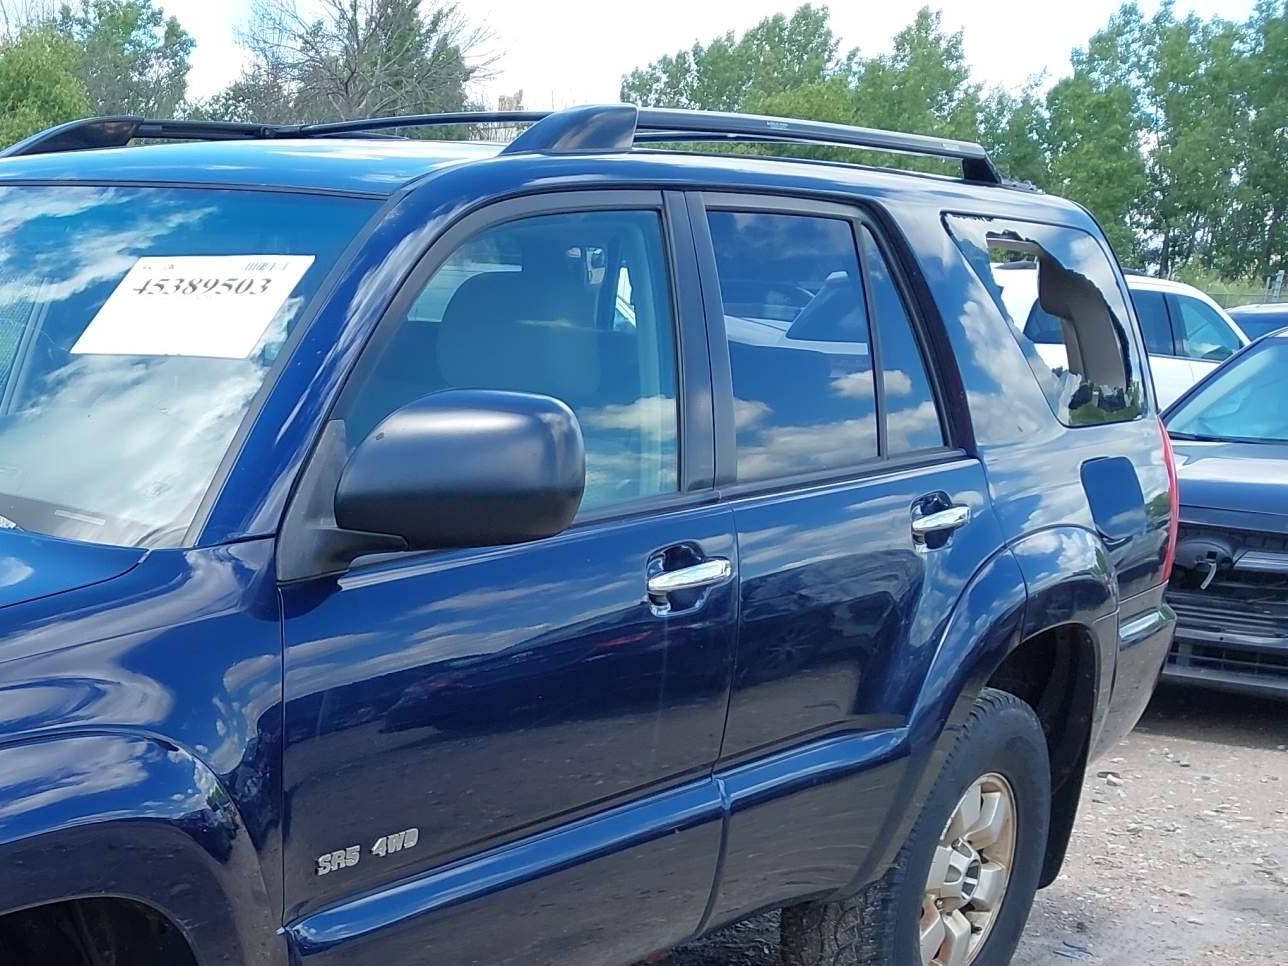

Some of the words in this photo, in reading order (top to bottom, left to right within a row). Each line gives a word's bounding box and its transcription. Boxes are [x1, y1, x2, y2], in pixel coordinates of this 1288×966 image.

[132, 277, 273, 296] 45389503
[317, 844, 361, 876] SR5
[371, 827, 419, 857] 4WD
